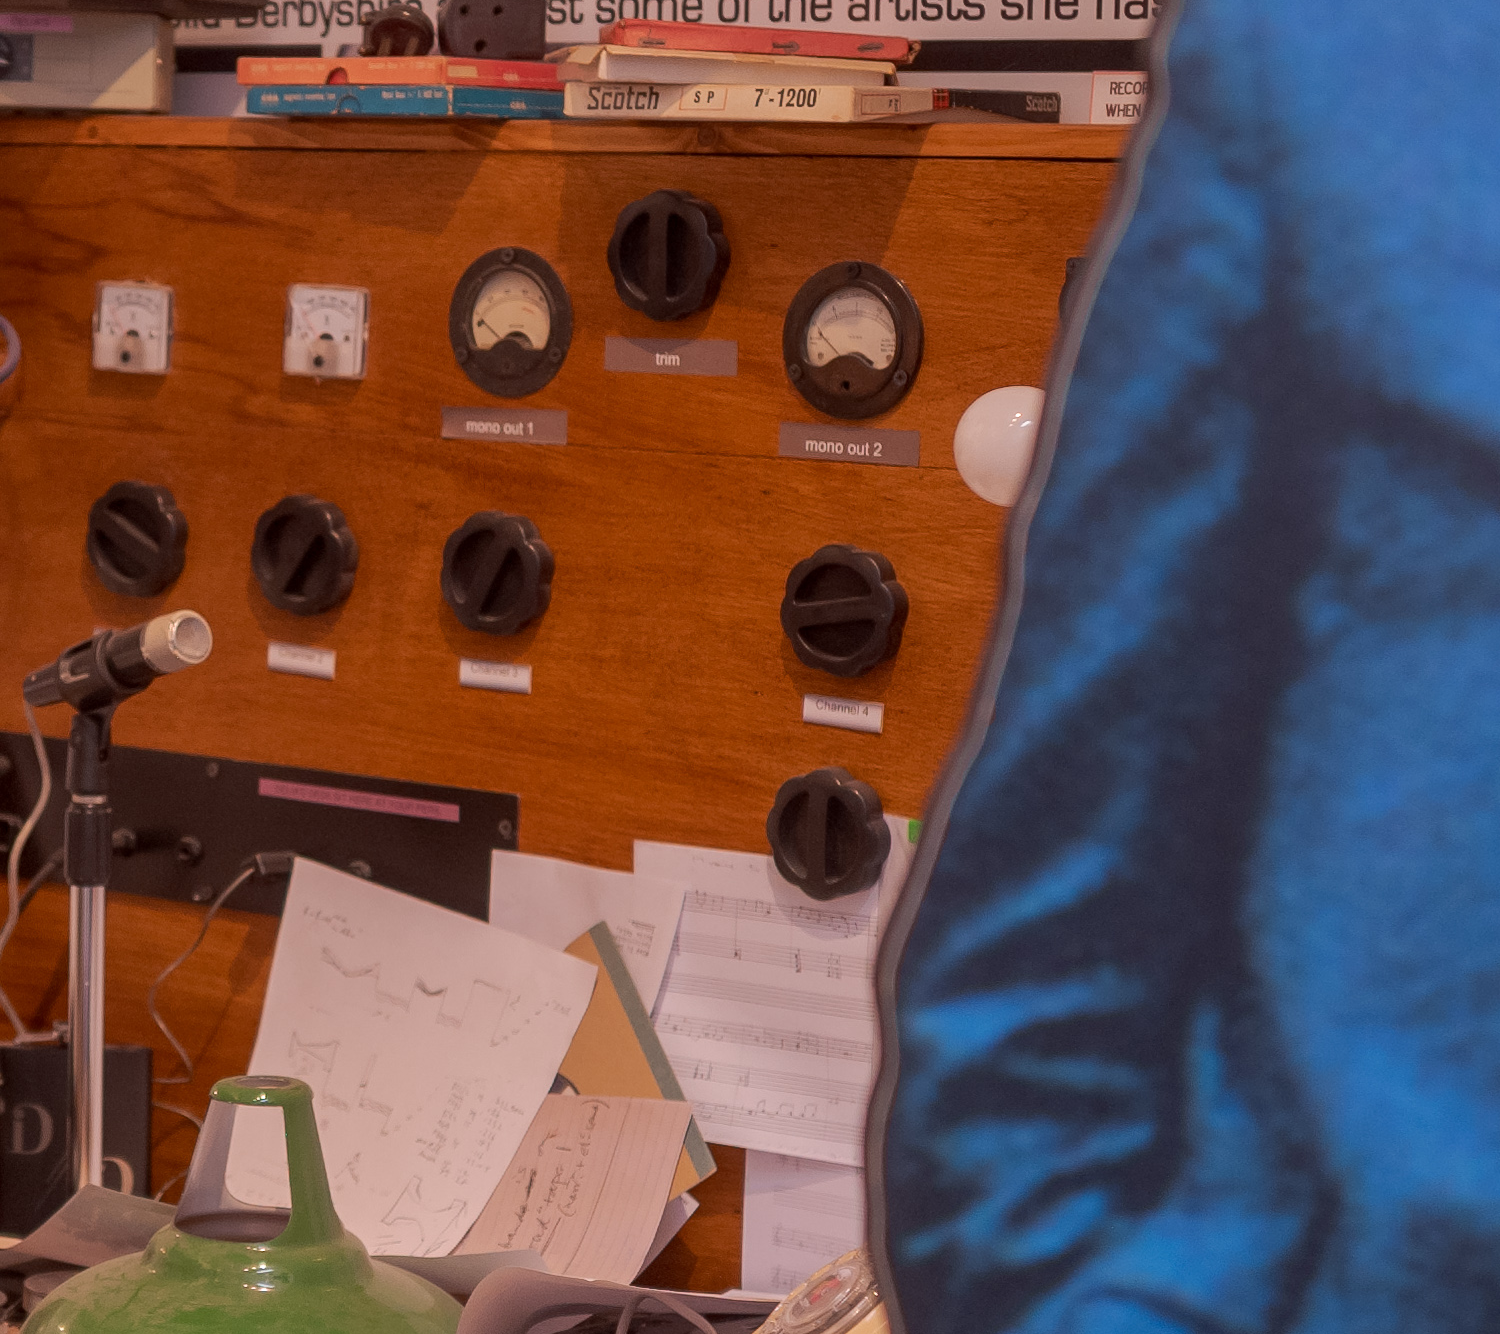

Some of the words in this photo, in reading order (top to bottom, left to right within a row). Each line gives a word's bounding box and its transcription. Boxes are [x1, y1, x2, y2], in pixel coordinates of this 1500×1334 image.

[586, 86, 660, 111] Scotch
[1024, 94, 1060, 113] Scotch
[654, 351, 681, 367] trim
[465, 421, 503, 436] mono
[504, 421, 525, 436] out
[805, 438, 845, 455] mono
[847, 440, 871, 456] out
[872, 442, 883, 457] 2
[815, 699, 859, 717] Channel
[861, 703, 870, 717] 4
